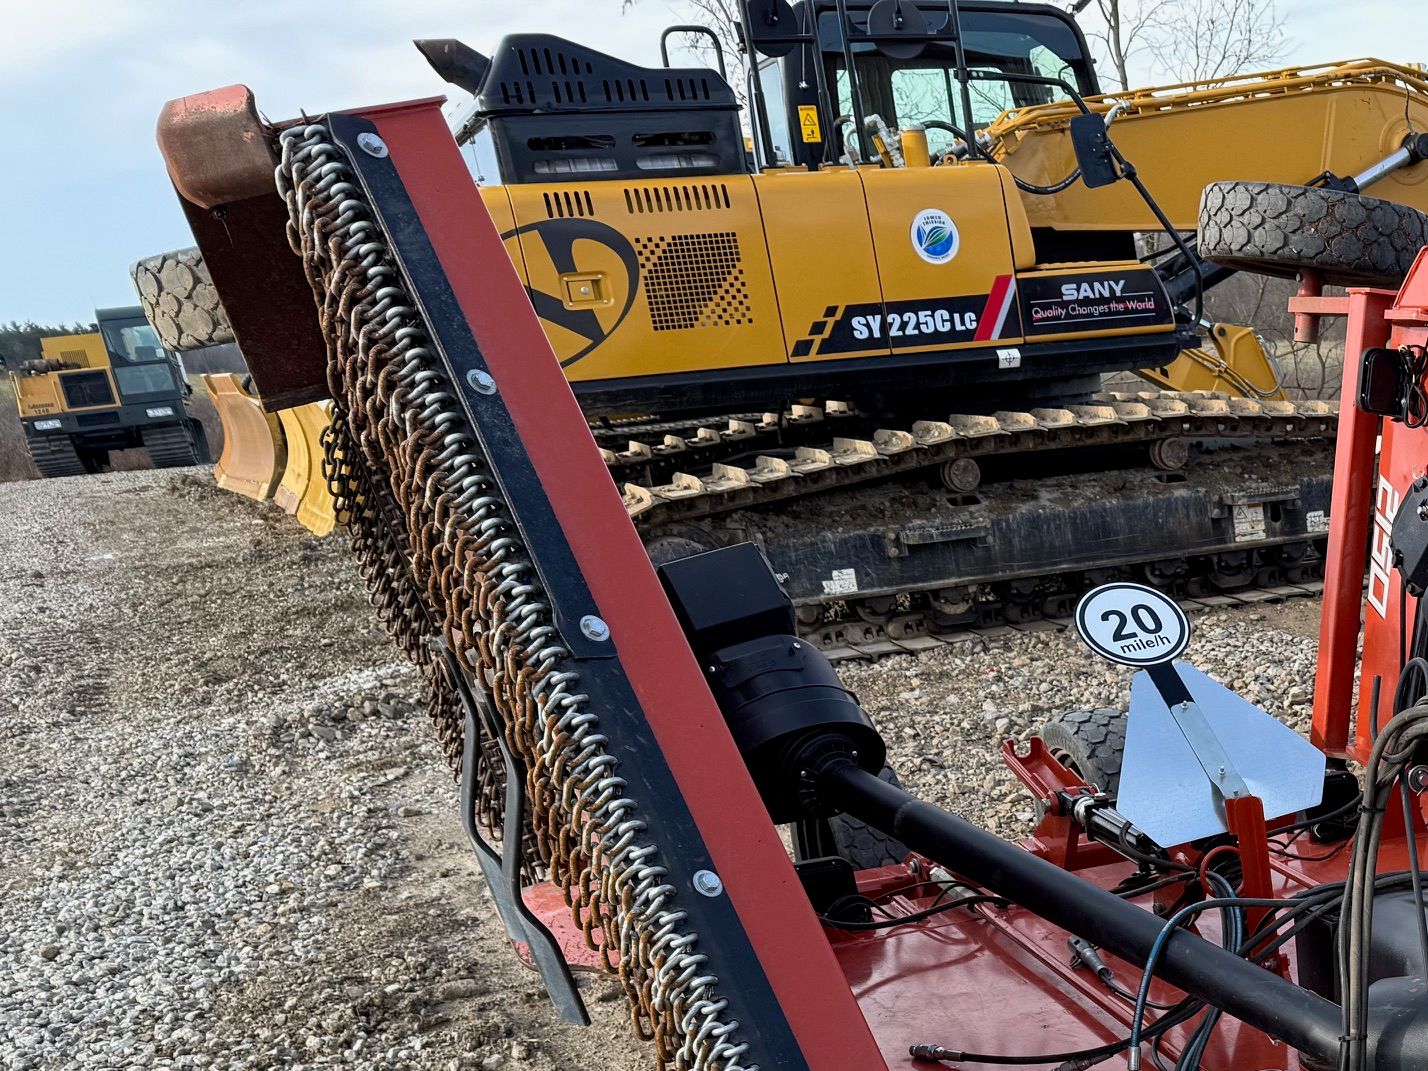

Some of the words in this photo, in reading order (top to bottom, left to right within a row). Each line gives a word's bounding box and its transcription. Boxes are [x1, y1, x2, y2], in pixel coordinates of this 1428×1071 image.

[1061, 279, 1126, 301] SANY
[1031, 304, 1067, 319] Quality
[1068, 302, 1109, 316] Changes
[1109, 300, 1125, 312] the
[1126, 296, 1155, 310] World
[1100, 603, 1163, 643] 20
[1120, 634, 1172, 654] mile/h
